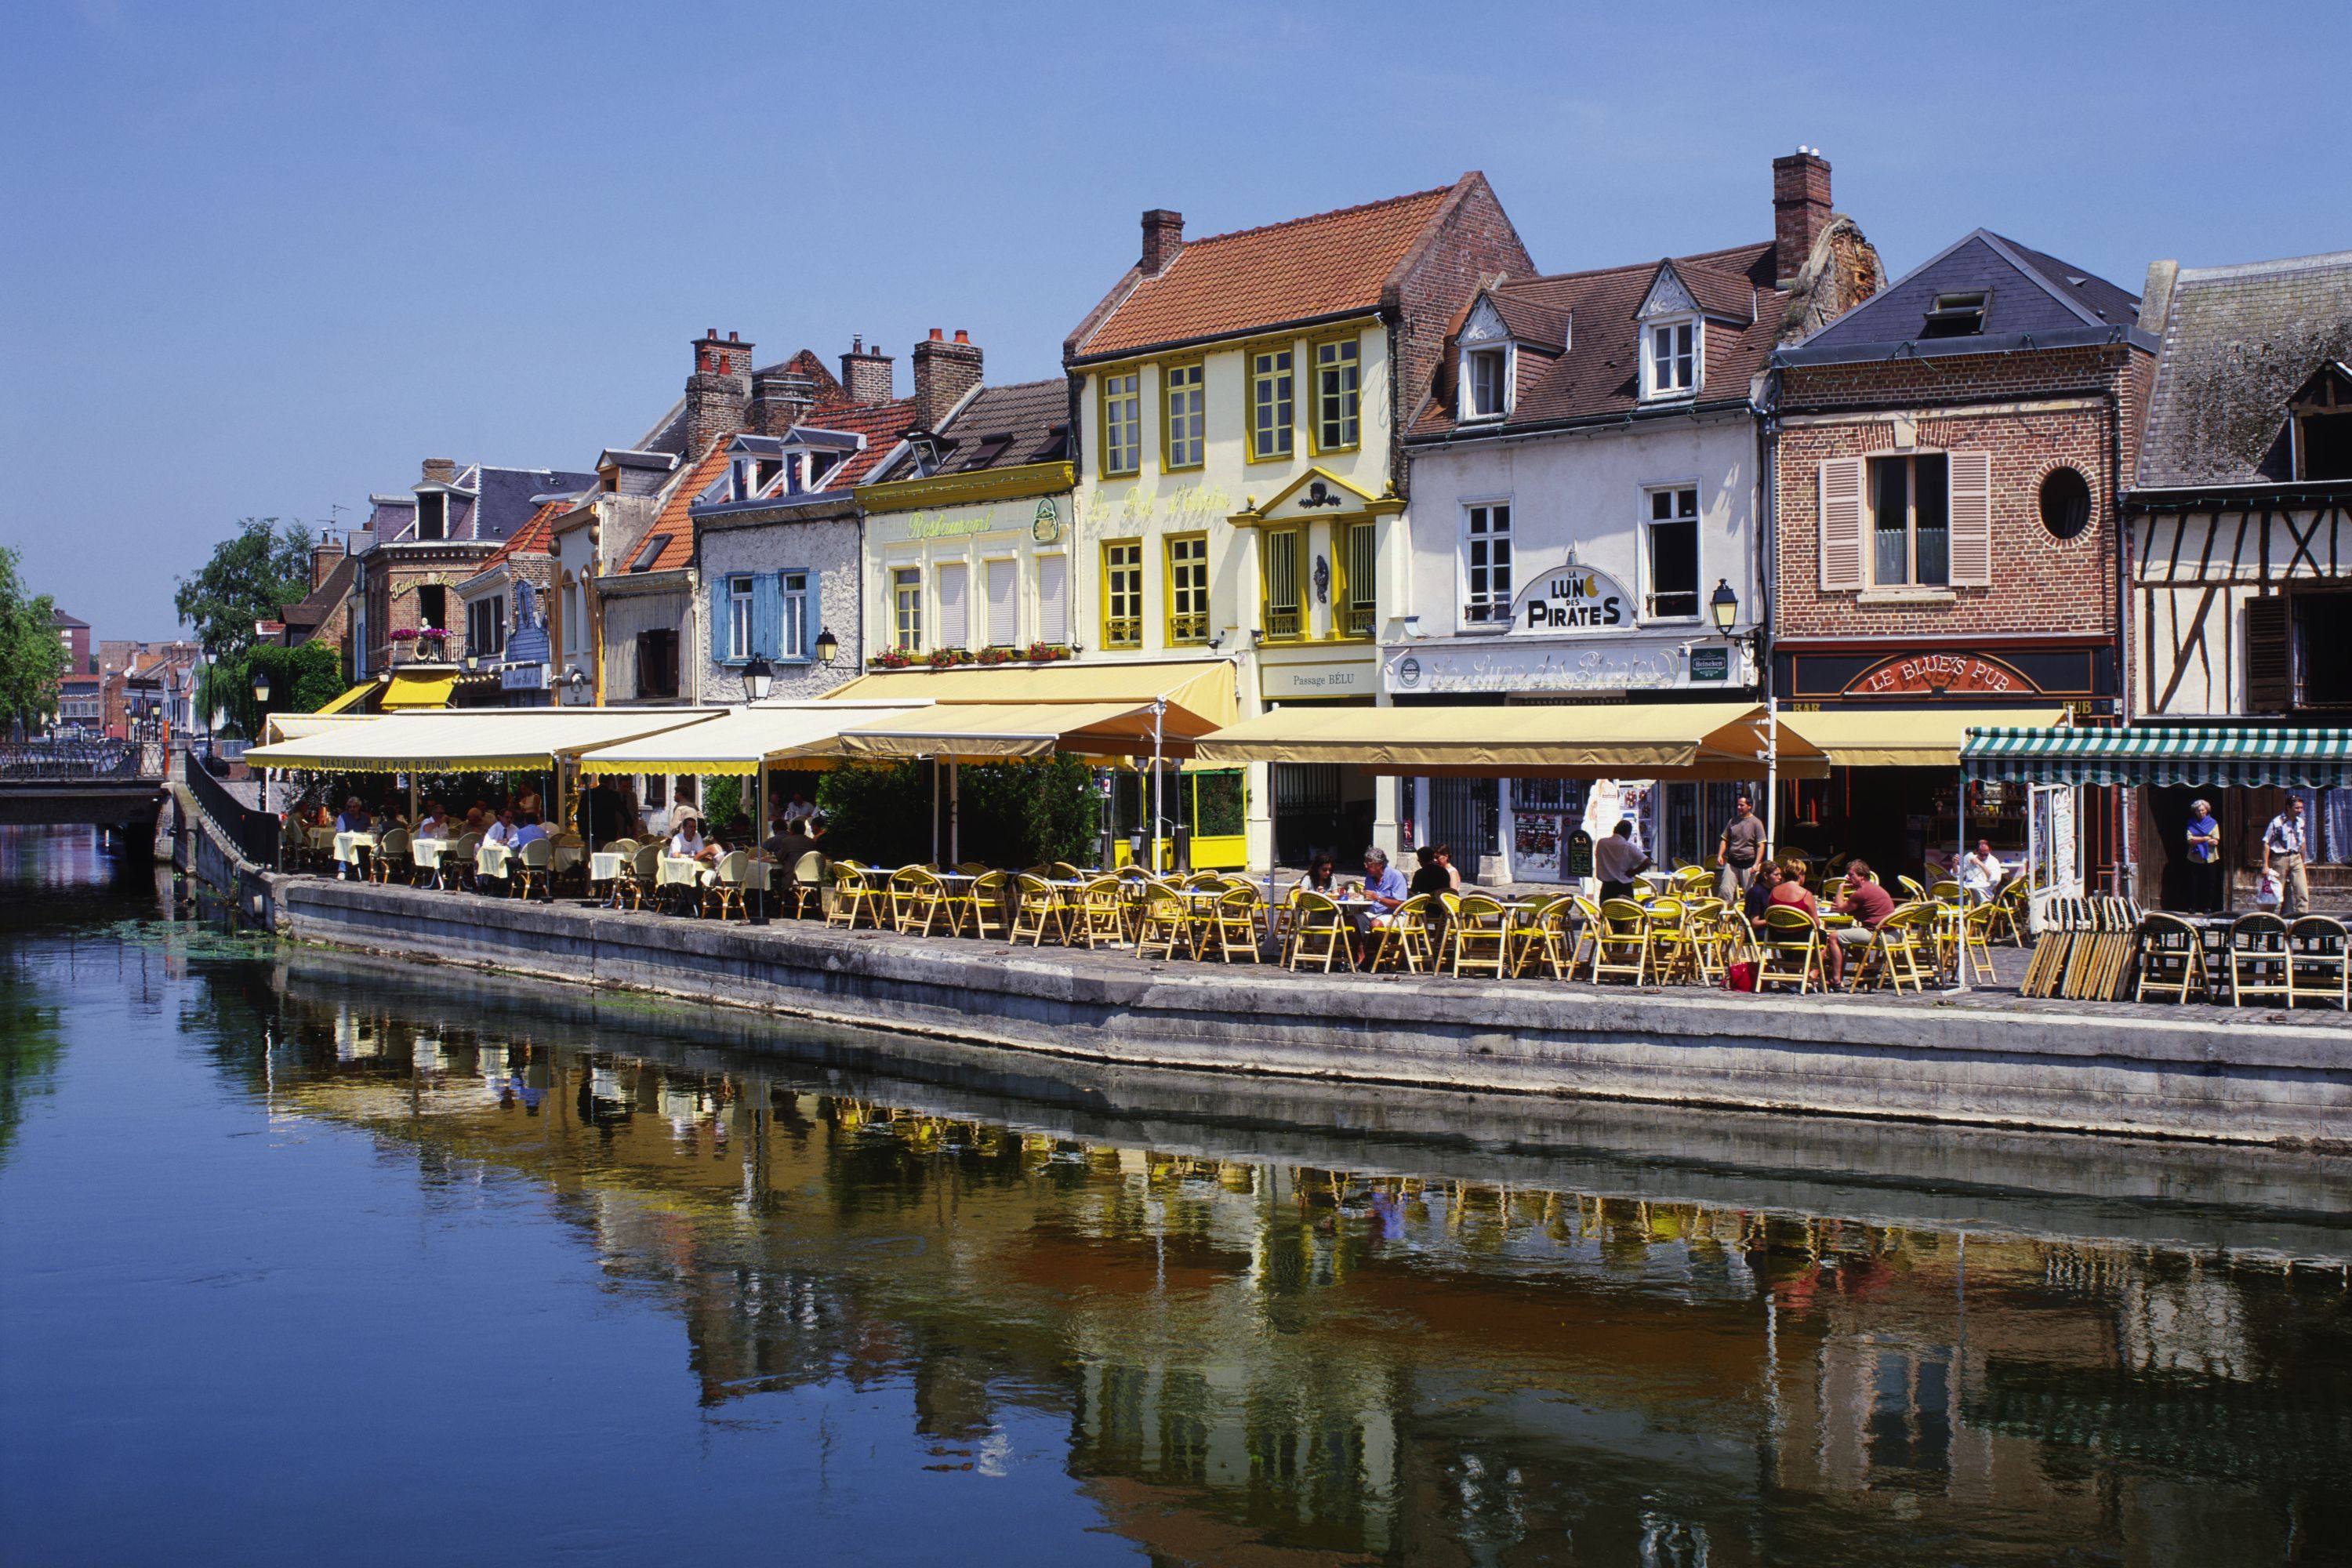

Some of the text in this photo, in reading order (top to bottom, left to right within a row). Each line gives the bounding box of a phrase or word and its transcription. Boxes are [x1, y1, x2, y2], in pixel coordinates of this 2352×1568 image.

[906, 508, 996, 539] Restaurant
[390, 575, 422, 599] Tante
[1528, 596, 1621, 628] PIRATES
[1566, 598, 1580, 607] DES
[1293, 671, 1354, 688] Passage BÉLU
[1868, 669, 1895, 691] LE
[1972, 660, 2010, 691] PUB
[1793, 702, 1820, 712] BAR
[321, 758, 451, 771] RESTAURANT LE POT D'ETAIN
